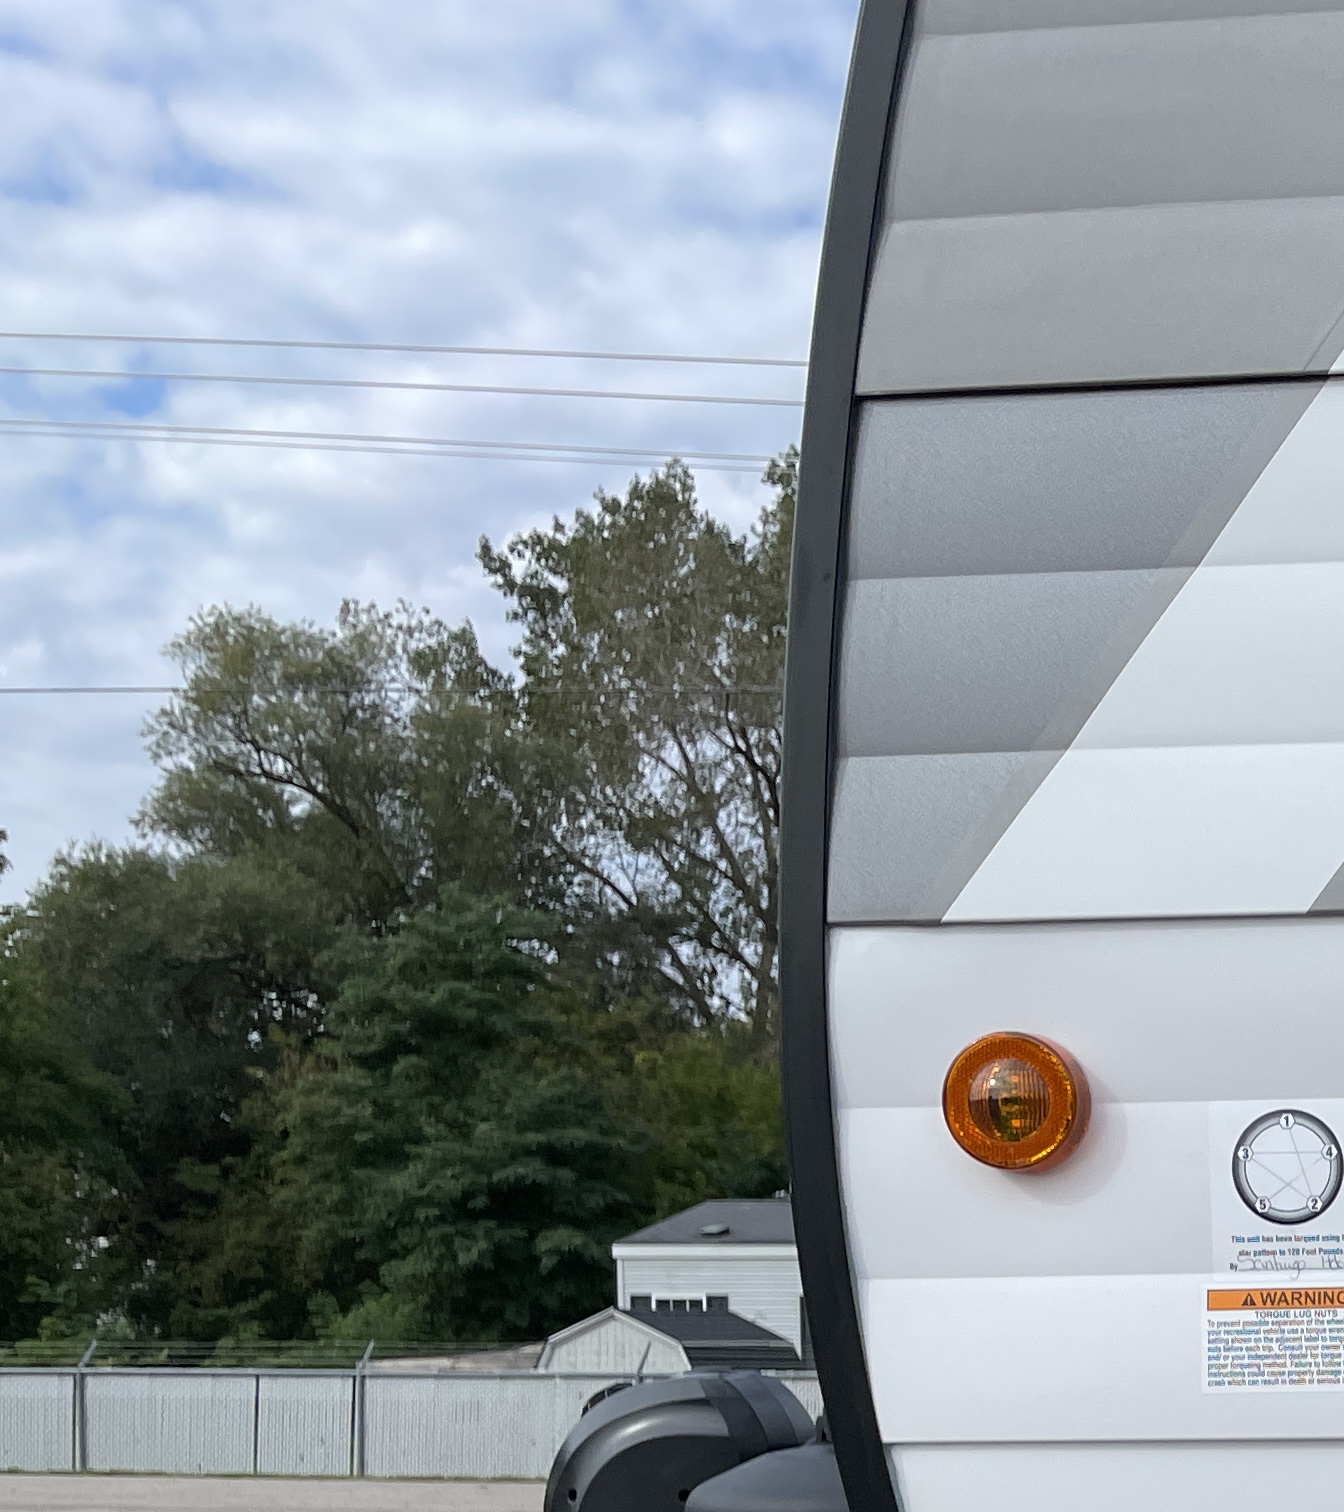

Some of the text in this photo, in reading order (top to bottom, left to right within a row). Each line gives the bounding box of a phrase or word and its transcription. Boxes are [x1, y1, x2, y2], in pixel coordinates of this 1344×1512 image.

[1283, 1116, 1290, 1127] 1
[1242, 1147, 1333, 1159] 3 4
[1260, 1199, 1318, 1210] 5 2
[1230, 1263, 1238, 1272] By
[1293, 1310, 1312, 1318] LUG
